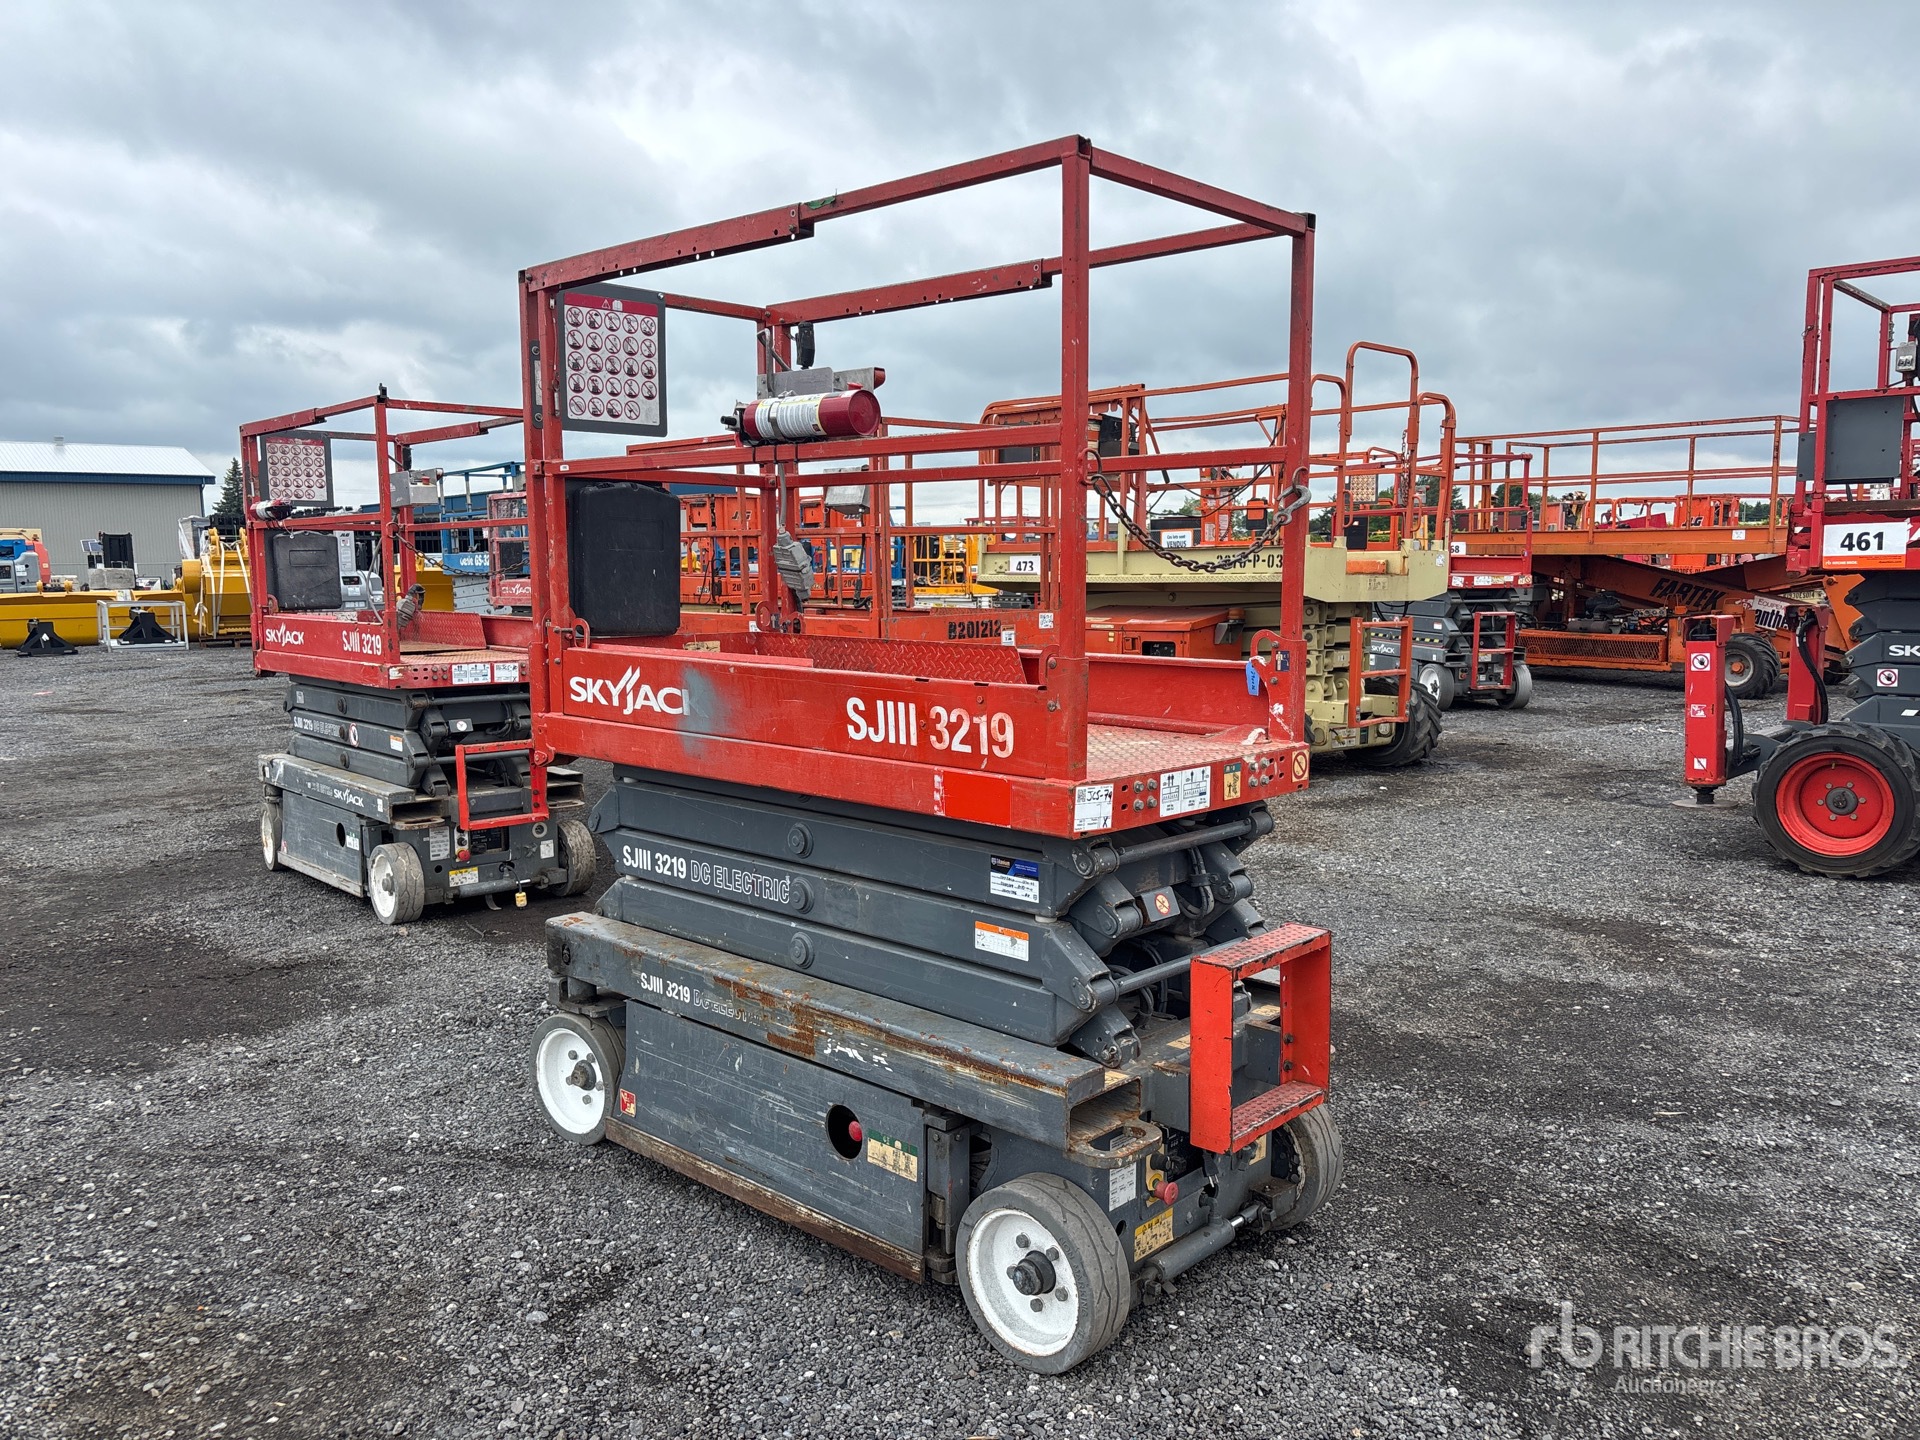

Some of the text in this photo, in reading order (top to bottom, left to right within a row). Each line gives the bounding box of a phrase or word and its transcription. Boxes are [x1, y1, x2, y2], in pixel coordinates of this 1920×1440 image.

[1166, 540, 1187, 548] VENDUS
[1840, 532, 1884, 551] 461
[1016, 561, 1034, 572] 473
[265, 622, 304, 647] SKYJACK
[947, 619, 1001, 640] B201212
[362, 633, 381, 655] 3219
[1371, 644, 1395, 654] SKYJACK
[846, 697, 1014, 758] SJIII 3219
[333, 787, 365, 807] SKYJACK
[623, 845, 790, 904] SJIII 3219 DC ELECTRIC
[640, 972, 663, 995] SJIII
[666, 980, 690, 1003] 3219
